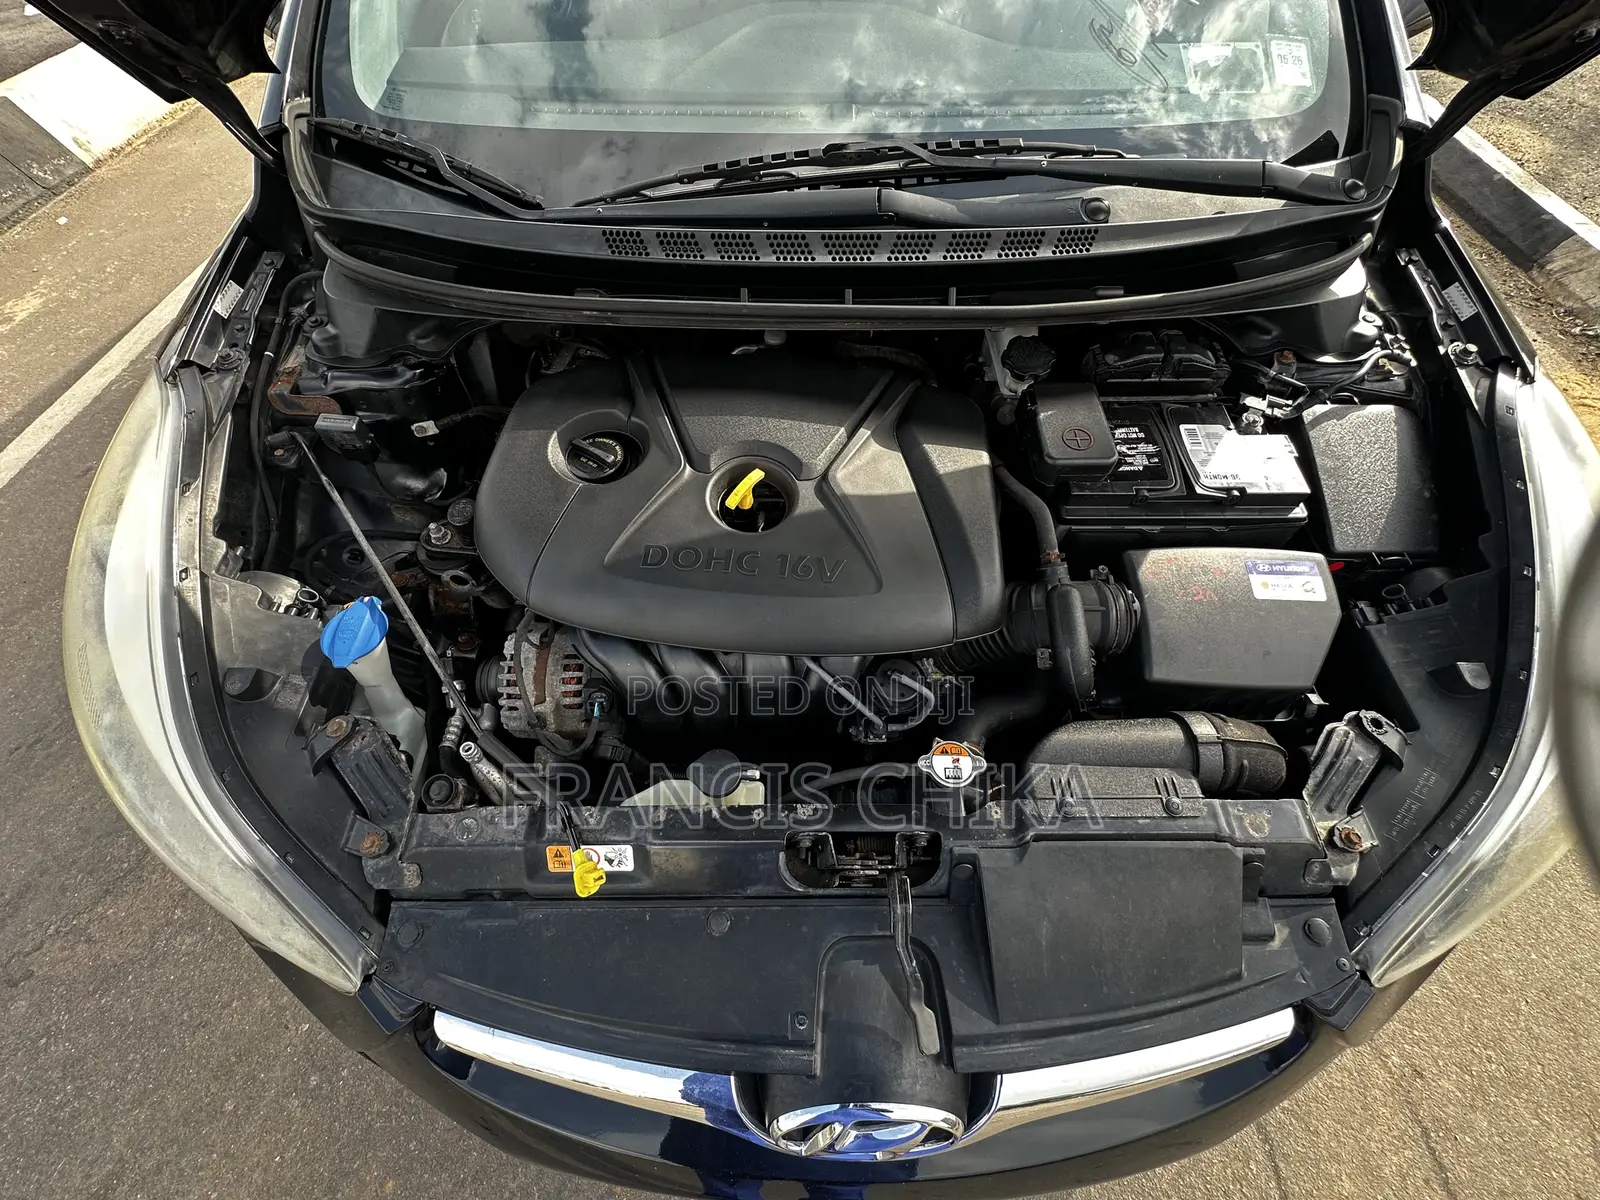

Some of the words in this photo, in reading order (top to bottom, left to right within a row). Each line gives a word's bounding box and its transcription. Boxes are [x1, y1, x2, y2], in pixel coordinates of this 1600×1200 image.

[1291, 55, 1304, 66] 26
[640, 544, 761, 575] DOHC
[776, 553, 847, 583] 16V
